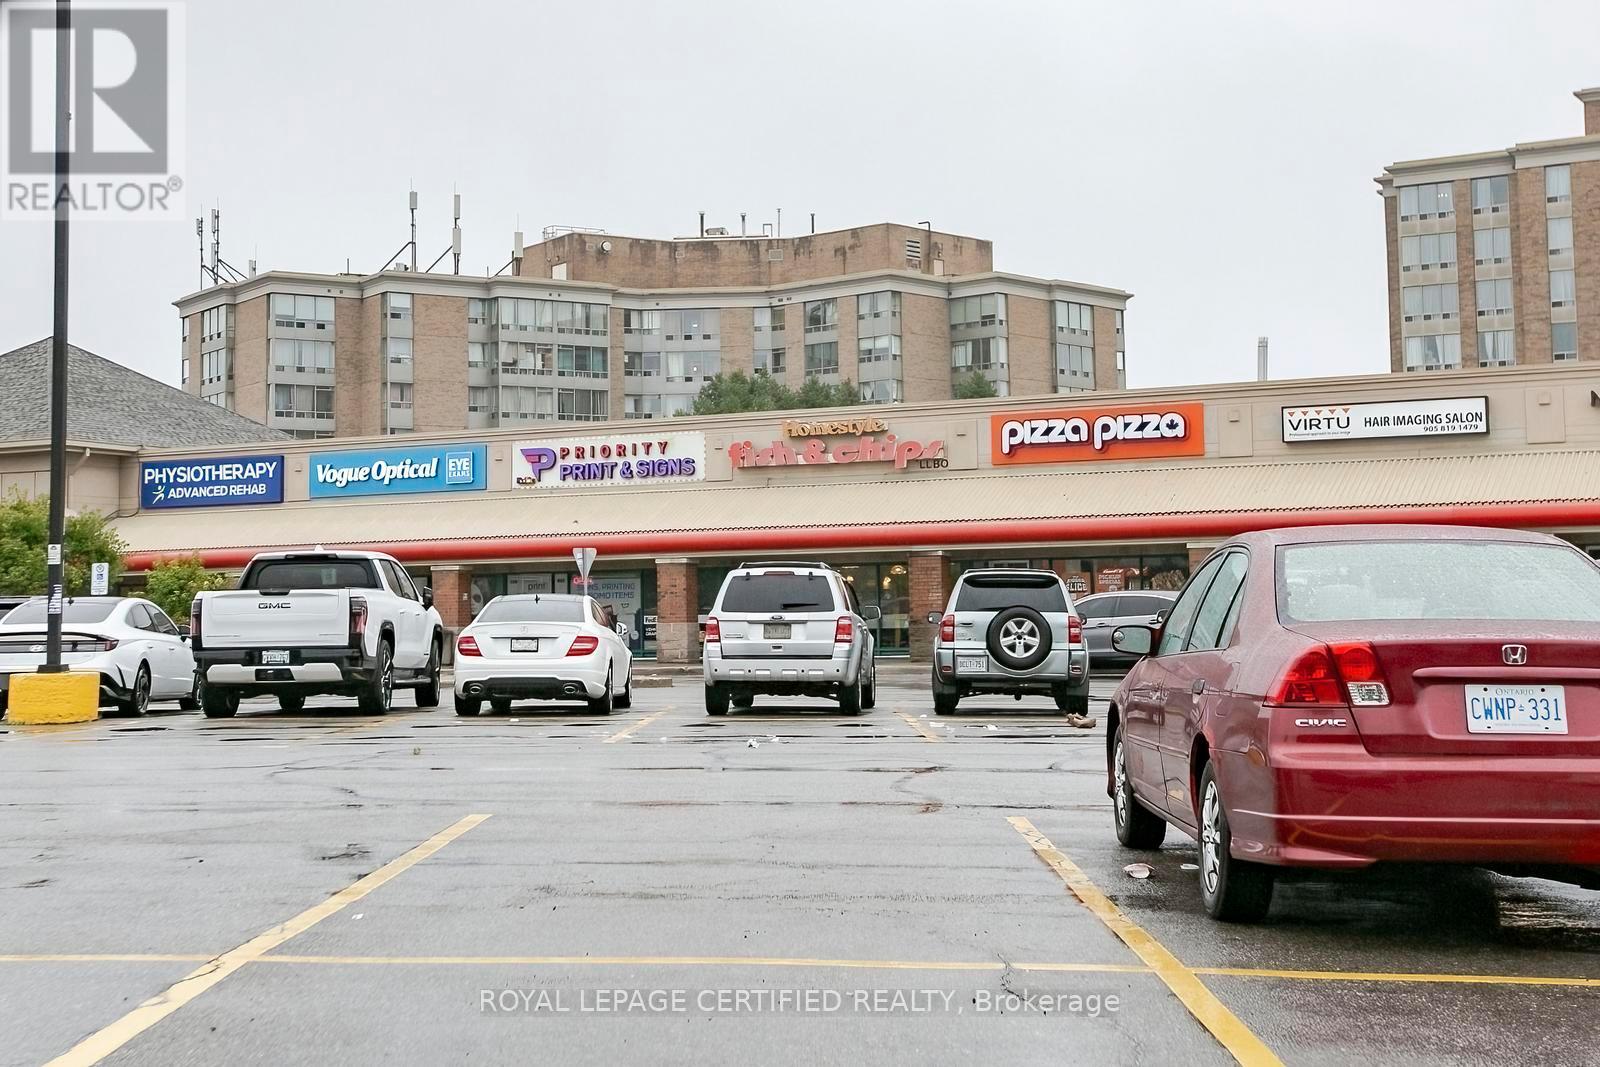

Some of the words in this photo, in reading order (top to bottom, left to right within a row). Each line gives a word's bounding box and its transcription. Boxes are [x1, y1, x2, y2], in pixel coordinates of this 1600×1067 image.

[1288, 416, 1350, 431] VIRTU
[1364, 415, 1394, 428] HAIR
[1393, 413, 1442, 426] IMAGING
[1445, 411, 1483, 424] SALON
[1423, 425, 1439, 433] 905
[1440, 424, 1456, 432] 819
[1458, 423, 1479, 431] 1479
[1001, 417, 1089, 454] pizza
[1093, 412, 1185, 450] pizza
[559, 440, 669, 461] PRIORITY
[728, 440, 798, 468] fish
[802, 438, 826, 465] &
[832, 434, 945, 469] chips
[448, 458, 470, 471] EYE
[559, 461, 618, 481] PRINT
[619, 460, 634, 479] &
[636, 457, 696, 477] SIGNS
[919, 458, 949, 469] LLBO
[144, 461, 277, 484] PHYSIOTHERAPY
[316, 463, 369, 488] Vogue
[371, 457, 438, 485] Optical
[167, 485, 228, 499] ADVANCED
[229, 483, 266, 496] REHAB
[1295, 718, 1347, 727] CIVIC
